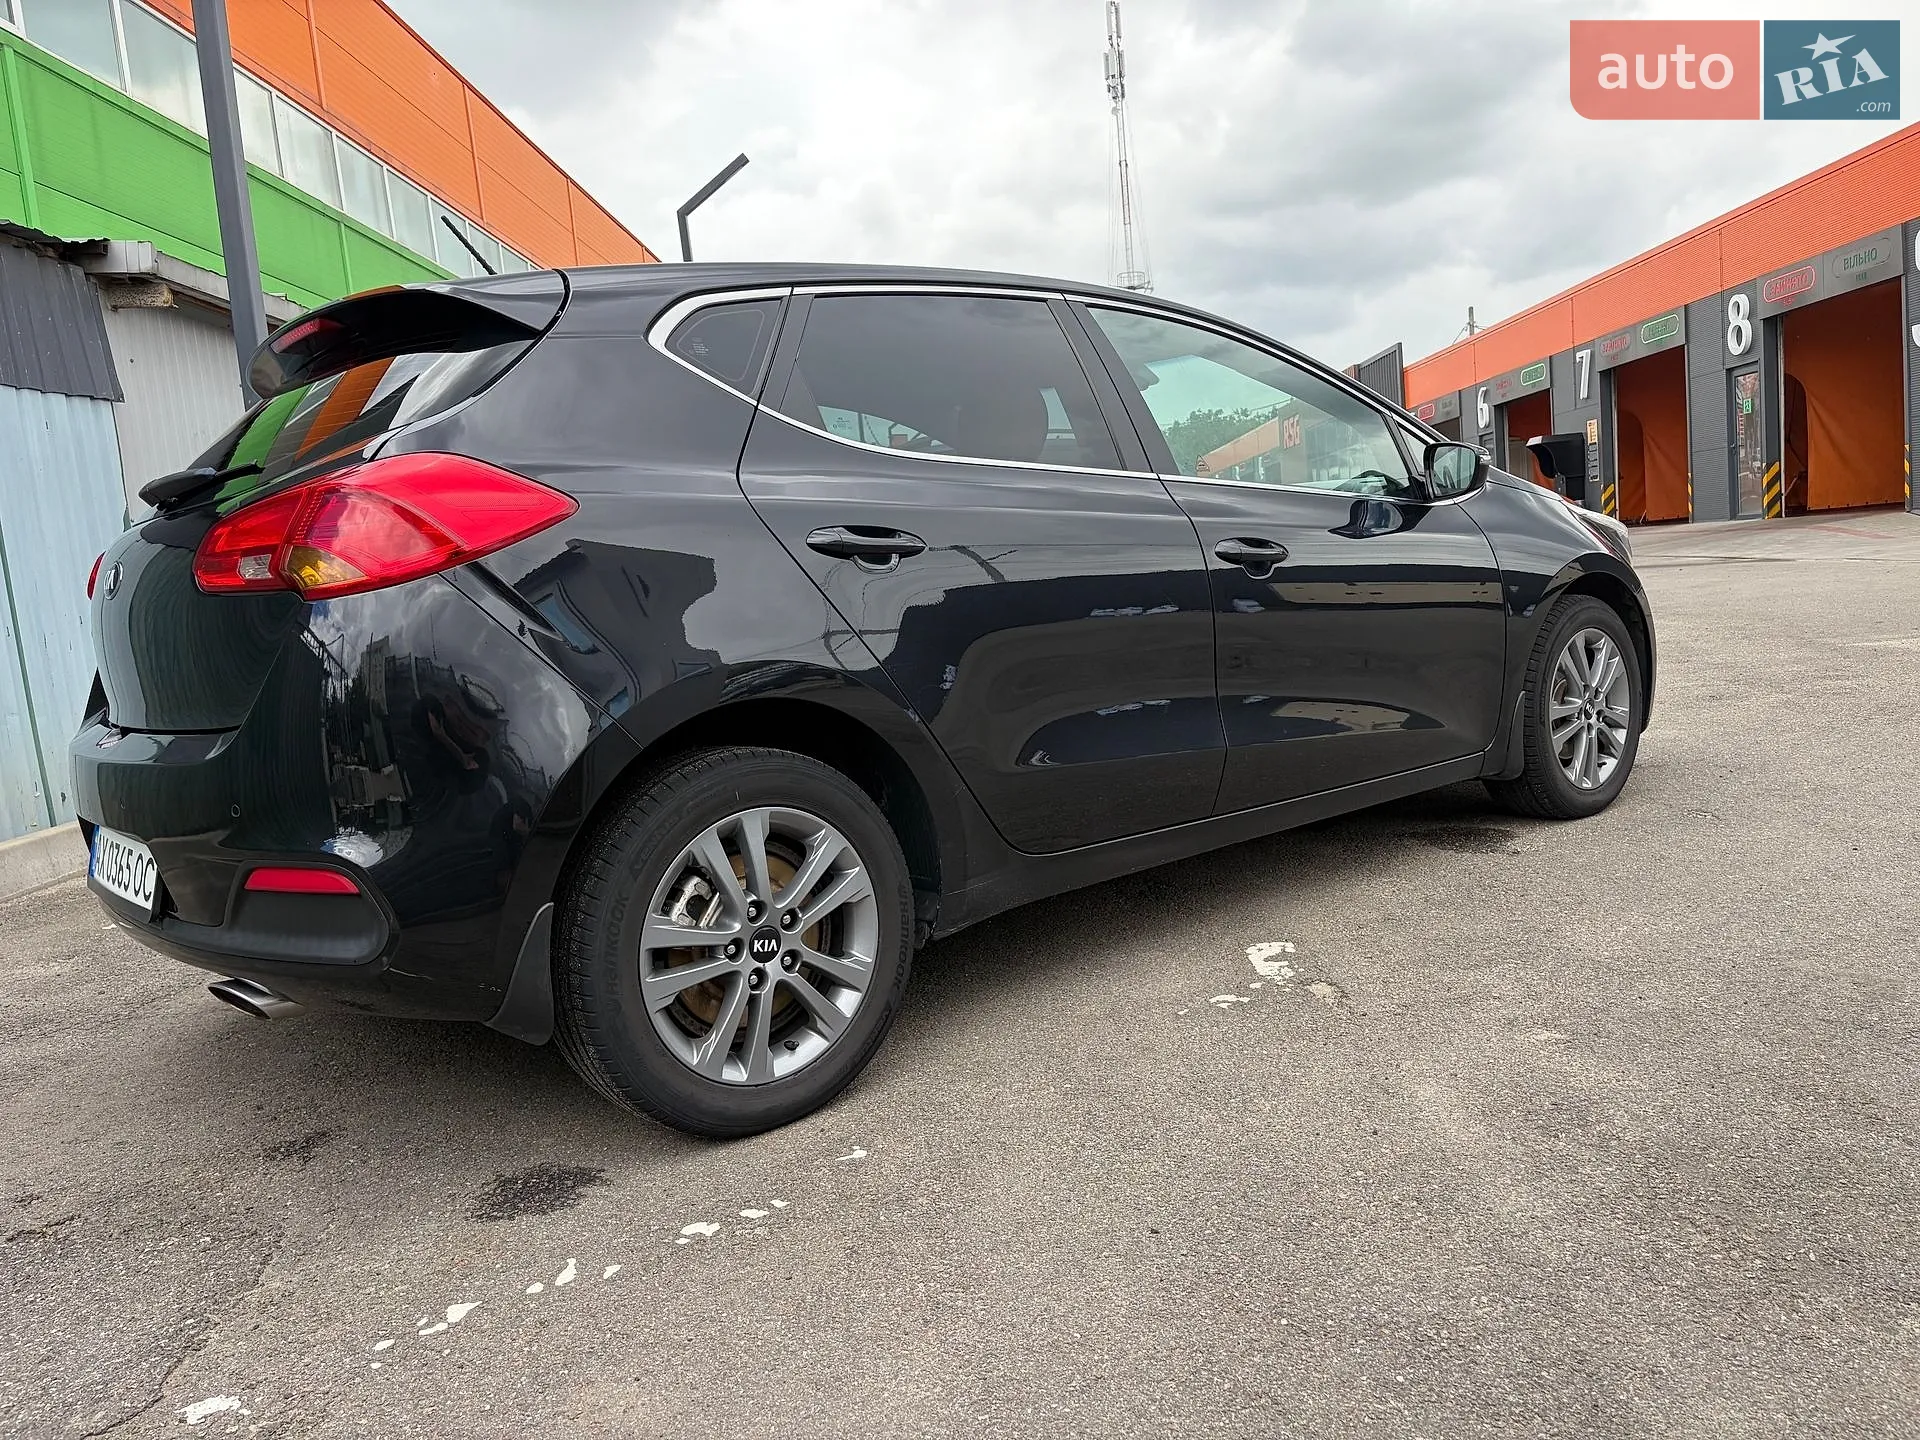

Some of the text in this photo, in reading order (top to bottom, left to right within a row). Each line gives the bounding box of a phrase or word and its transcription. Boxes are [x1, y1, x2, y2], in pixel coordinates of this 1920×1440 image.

[1843, 247, 1878, 271] ВІЛЬНО
[1727, 293, 1752, 356] 8
[1576, 349, 1591, 400] 7
[1477, 386, 1490, 429] 6
[753, 938, 778, 953] KIA
